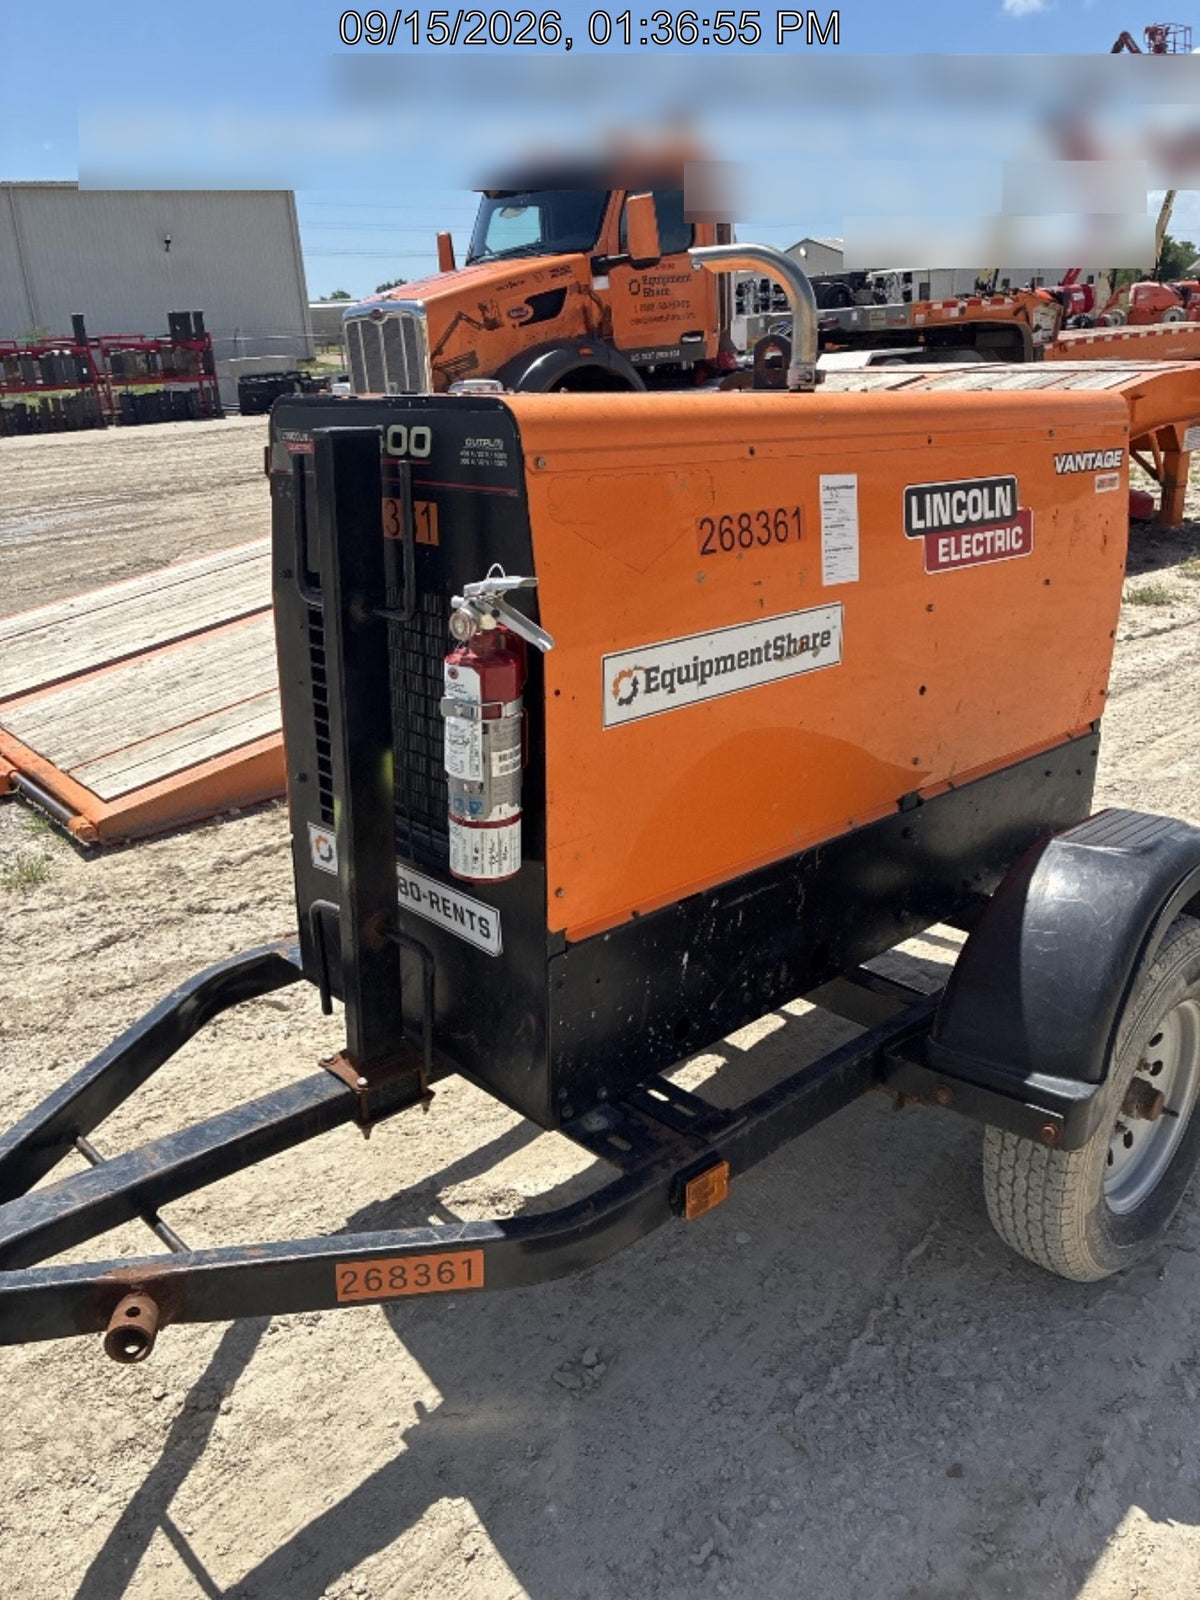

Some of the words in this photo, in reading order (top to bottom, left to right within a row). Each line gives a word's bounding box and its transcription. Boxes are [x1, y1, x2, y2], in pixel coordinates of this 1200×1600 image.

[380, 424, 432, 458] 00
[1053, 448, 1124, 475] VANTAGE
[911, 485, 1012, 530] LINCOLN
[699, 507, 801, 556] 268361
[937, 526, 1024, 564] ELECTRIC
[643, 629, 831, 695] EquipmentShare
[340, 1258, 472, 1295] 268361
